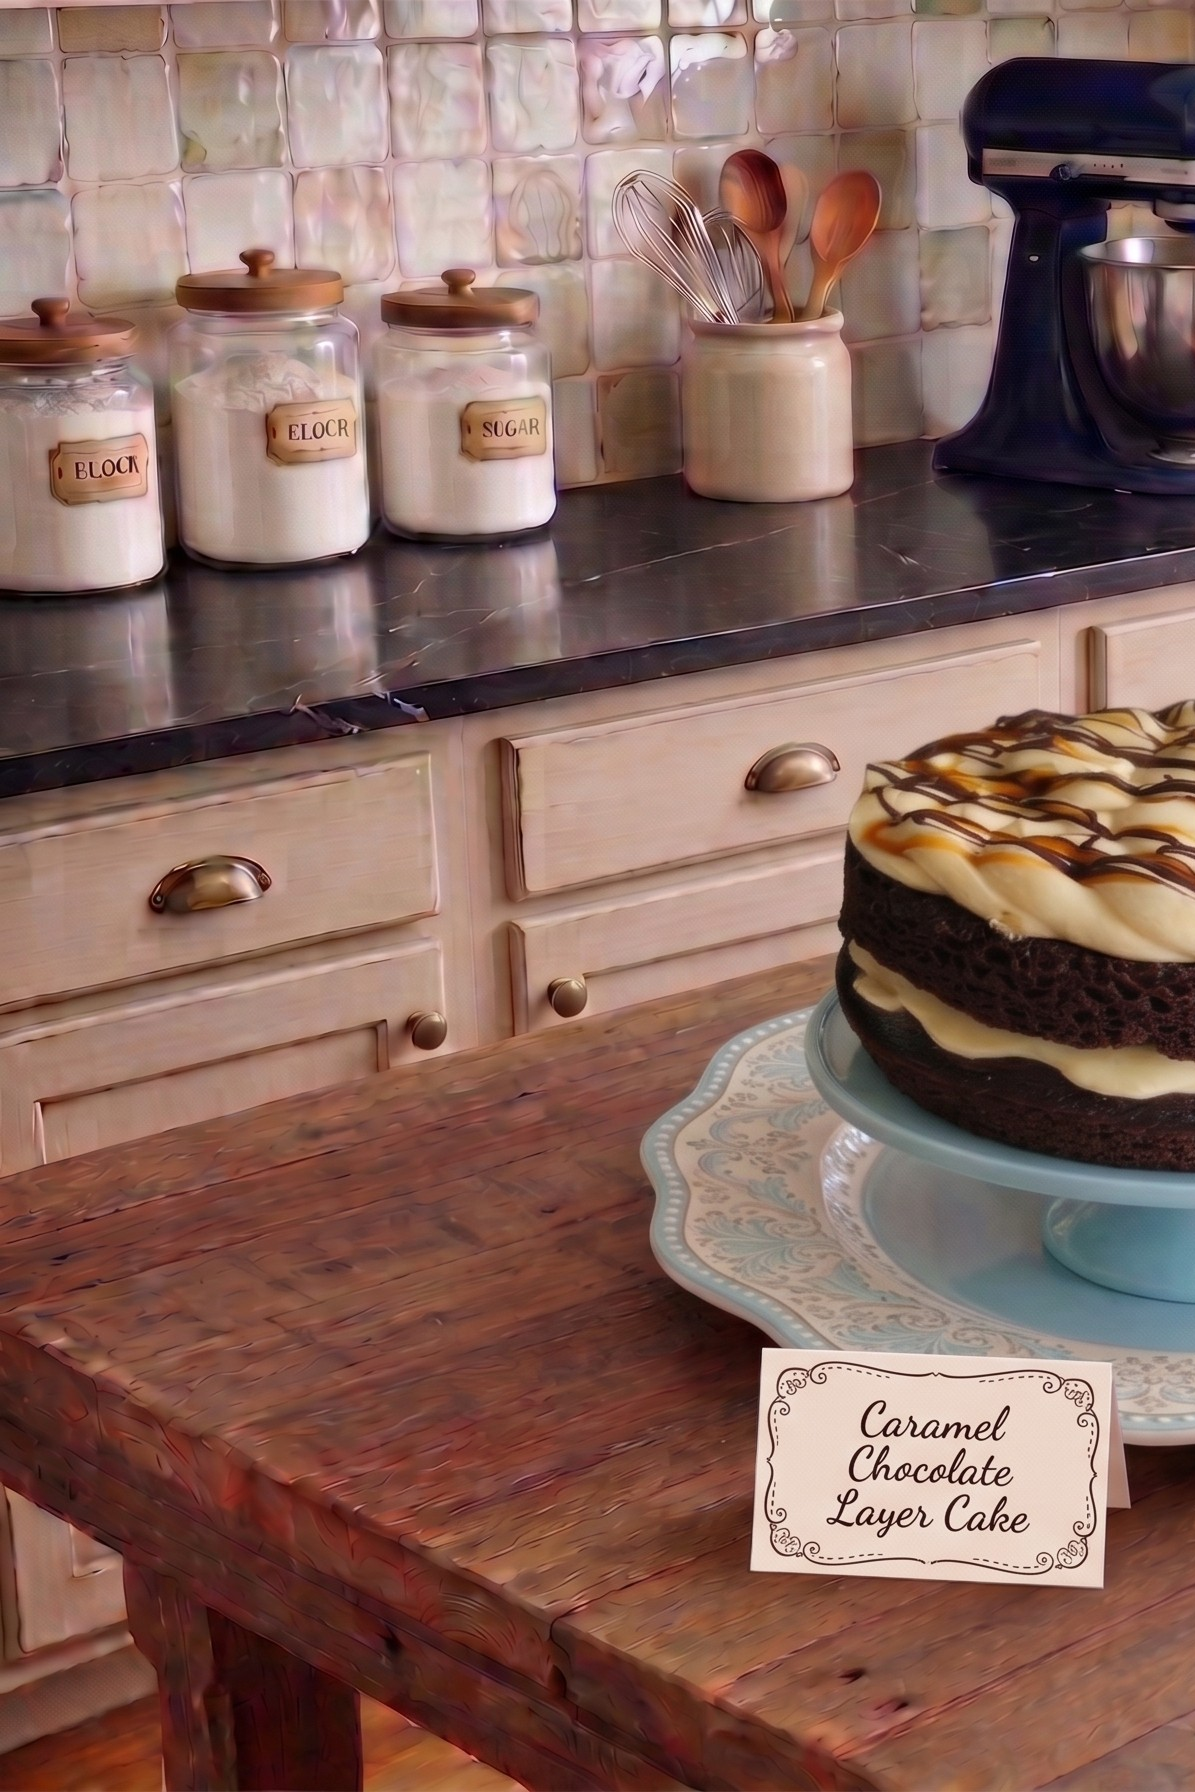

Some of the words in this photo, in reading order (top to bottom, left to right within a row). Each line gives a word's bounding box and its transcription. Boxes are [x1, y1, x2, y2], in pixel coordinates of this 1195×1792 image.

[482, 418, 540, 438] SUGAR
[860, 1399, 1011, 1442] Caramel
[848, 1444, 1014, 1487] Chocolate
[826, 1488, 934, 1538] Layer
[944, 1493, 1031, 1534] Cake
